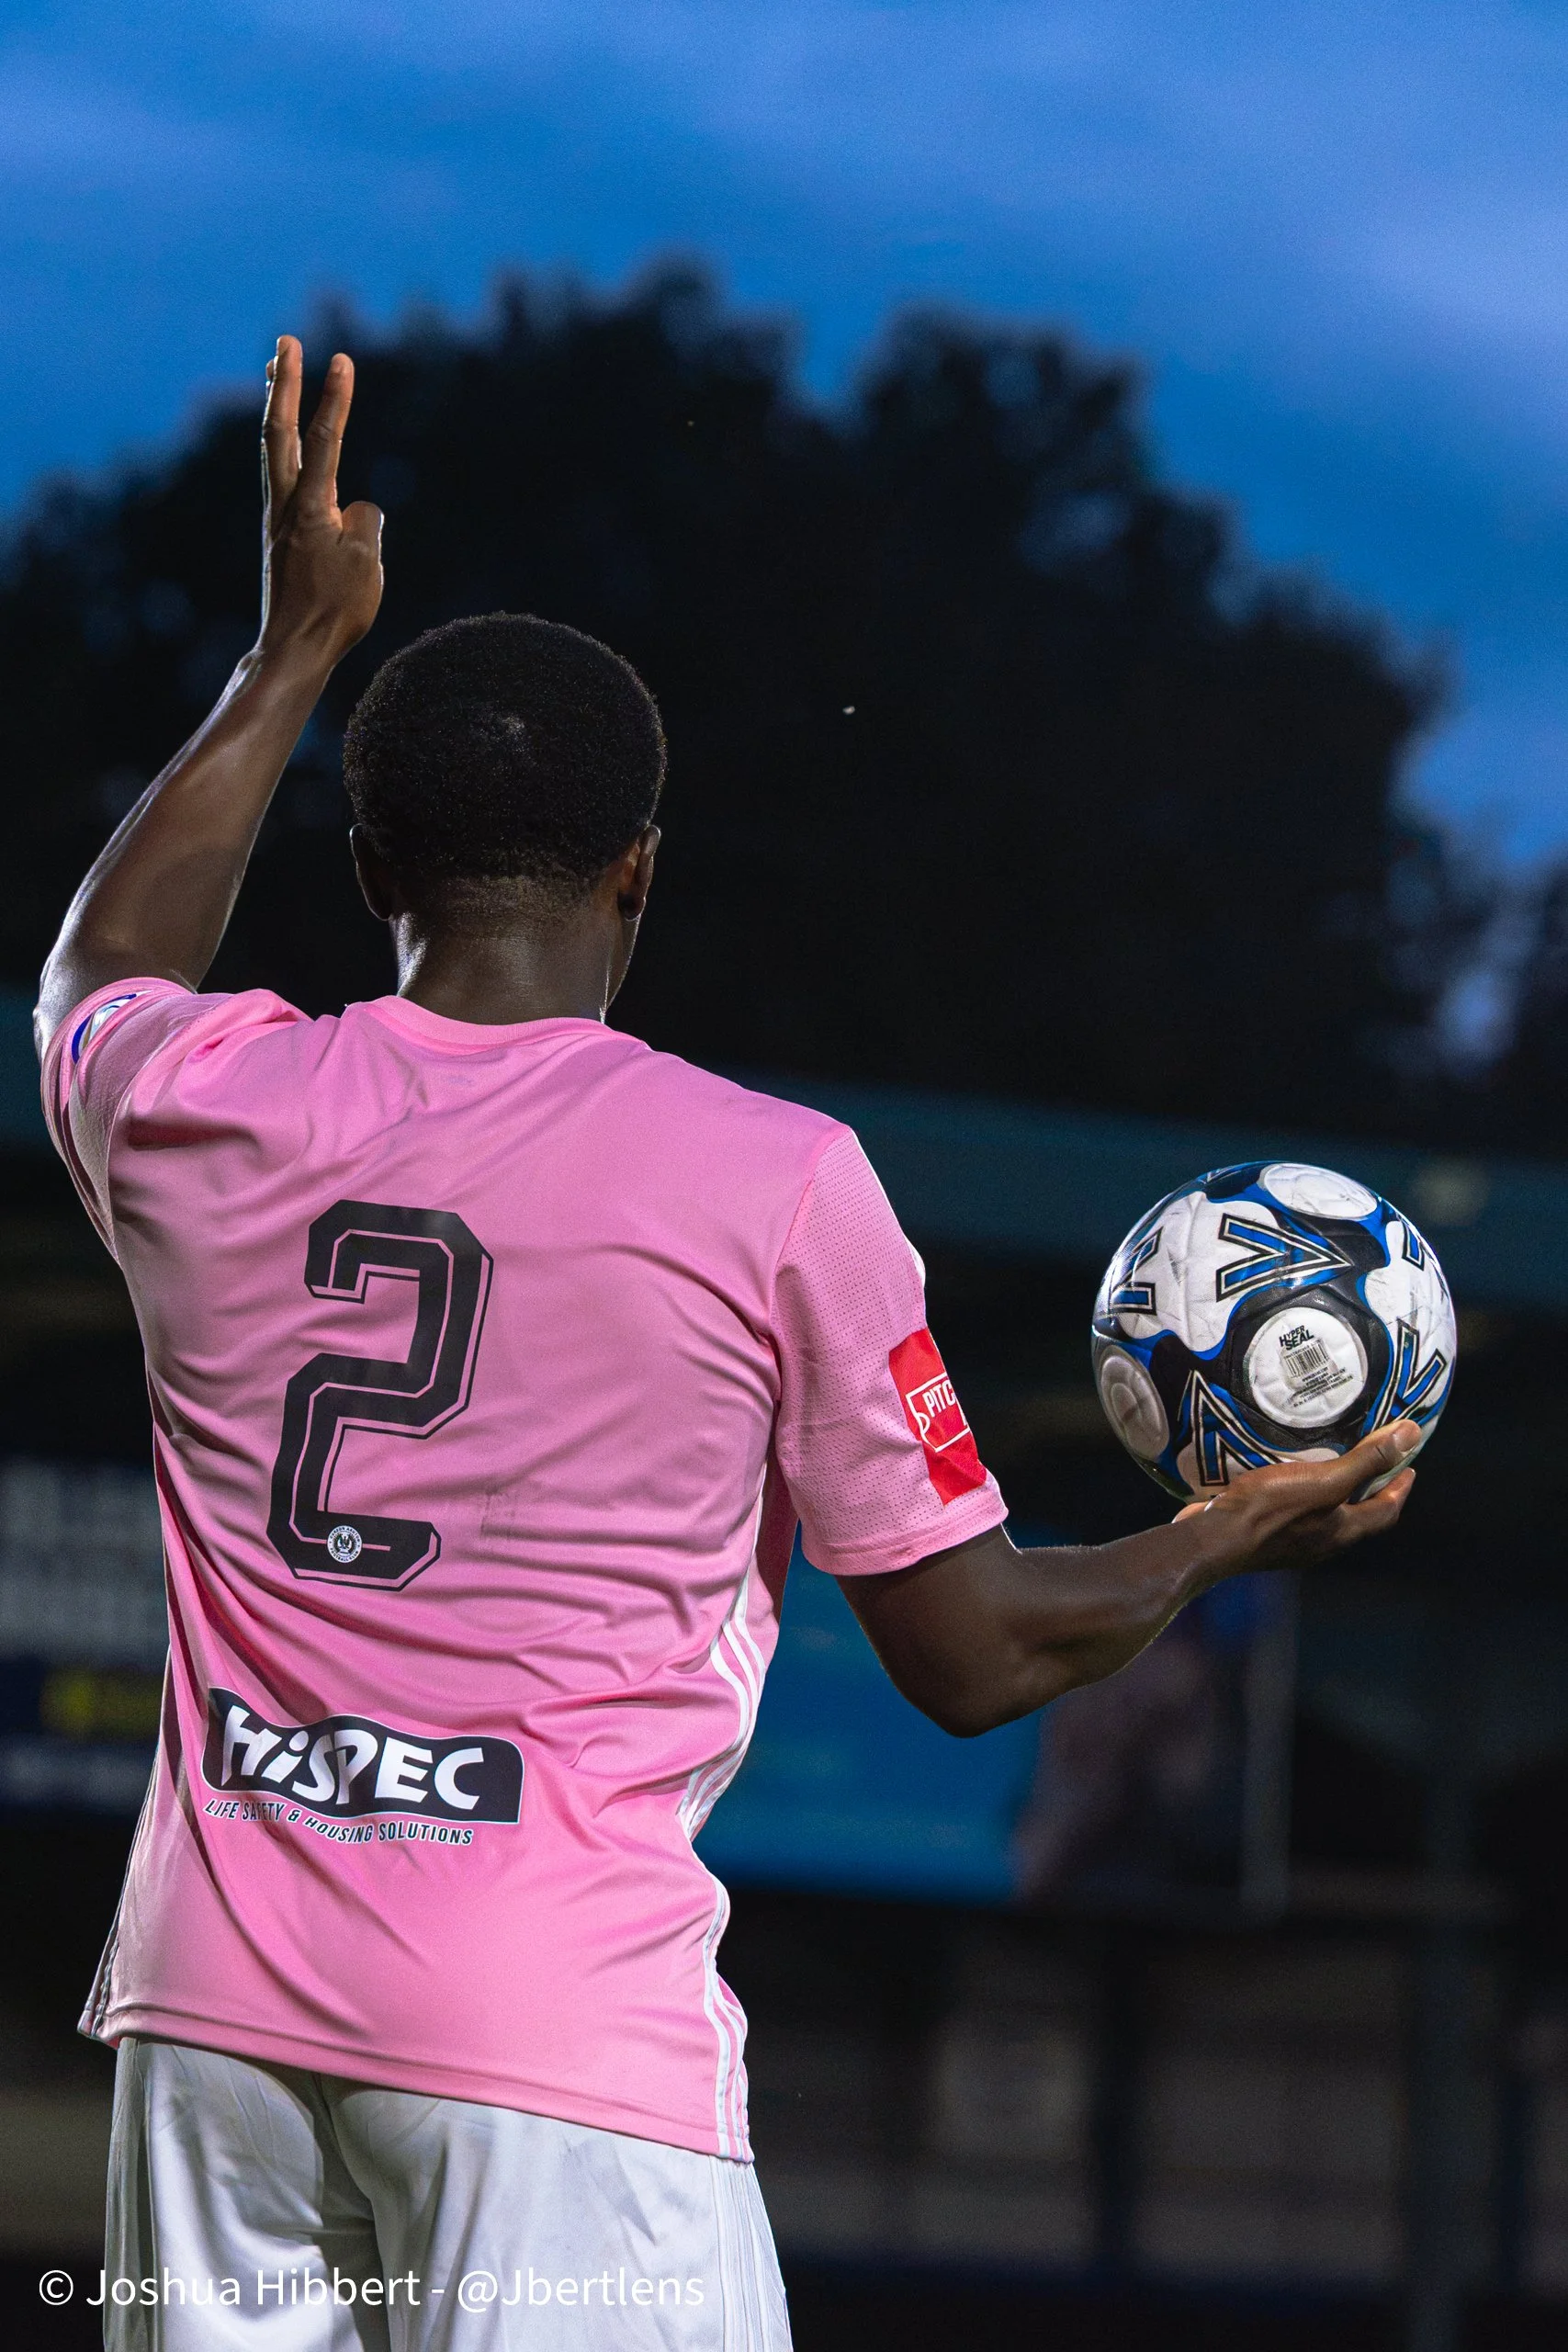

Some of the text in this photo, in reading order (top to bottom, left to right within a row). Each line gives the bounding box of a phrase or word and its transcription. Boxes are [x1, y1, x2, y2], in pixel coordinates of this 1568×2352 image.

[1279, 1325, 1305, 1347] HYPER
[1285, 1329, 1314, 1351] SEAL
[266, 1199, 493, 1591] 2
[204, 1798, 473, 1845] LIFE SAFETY & HOUSING SOLUTIONS
